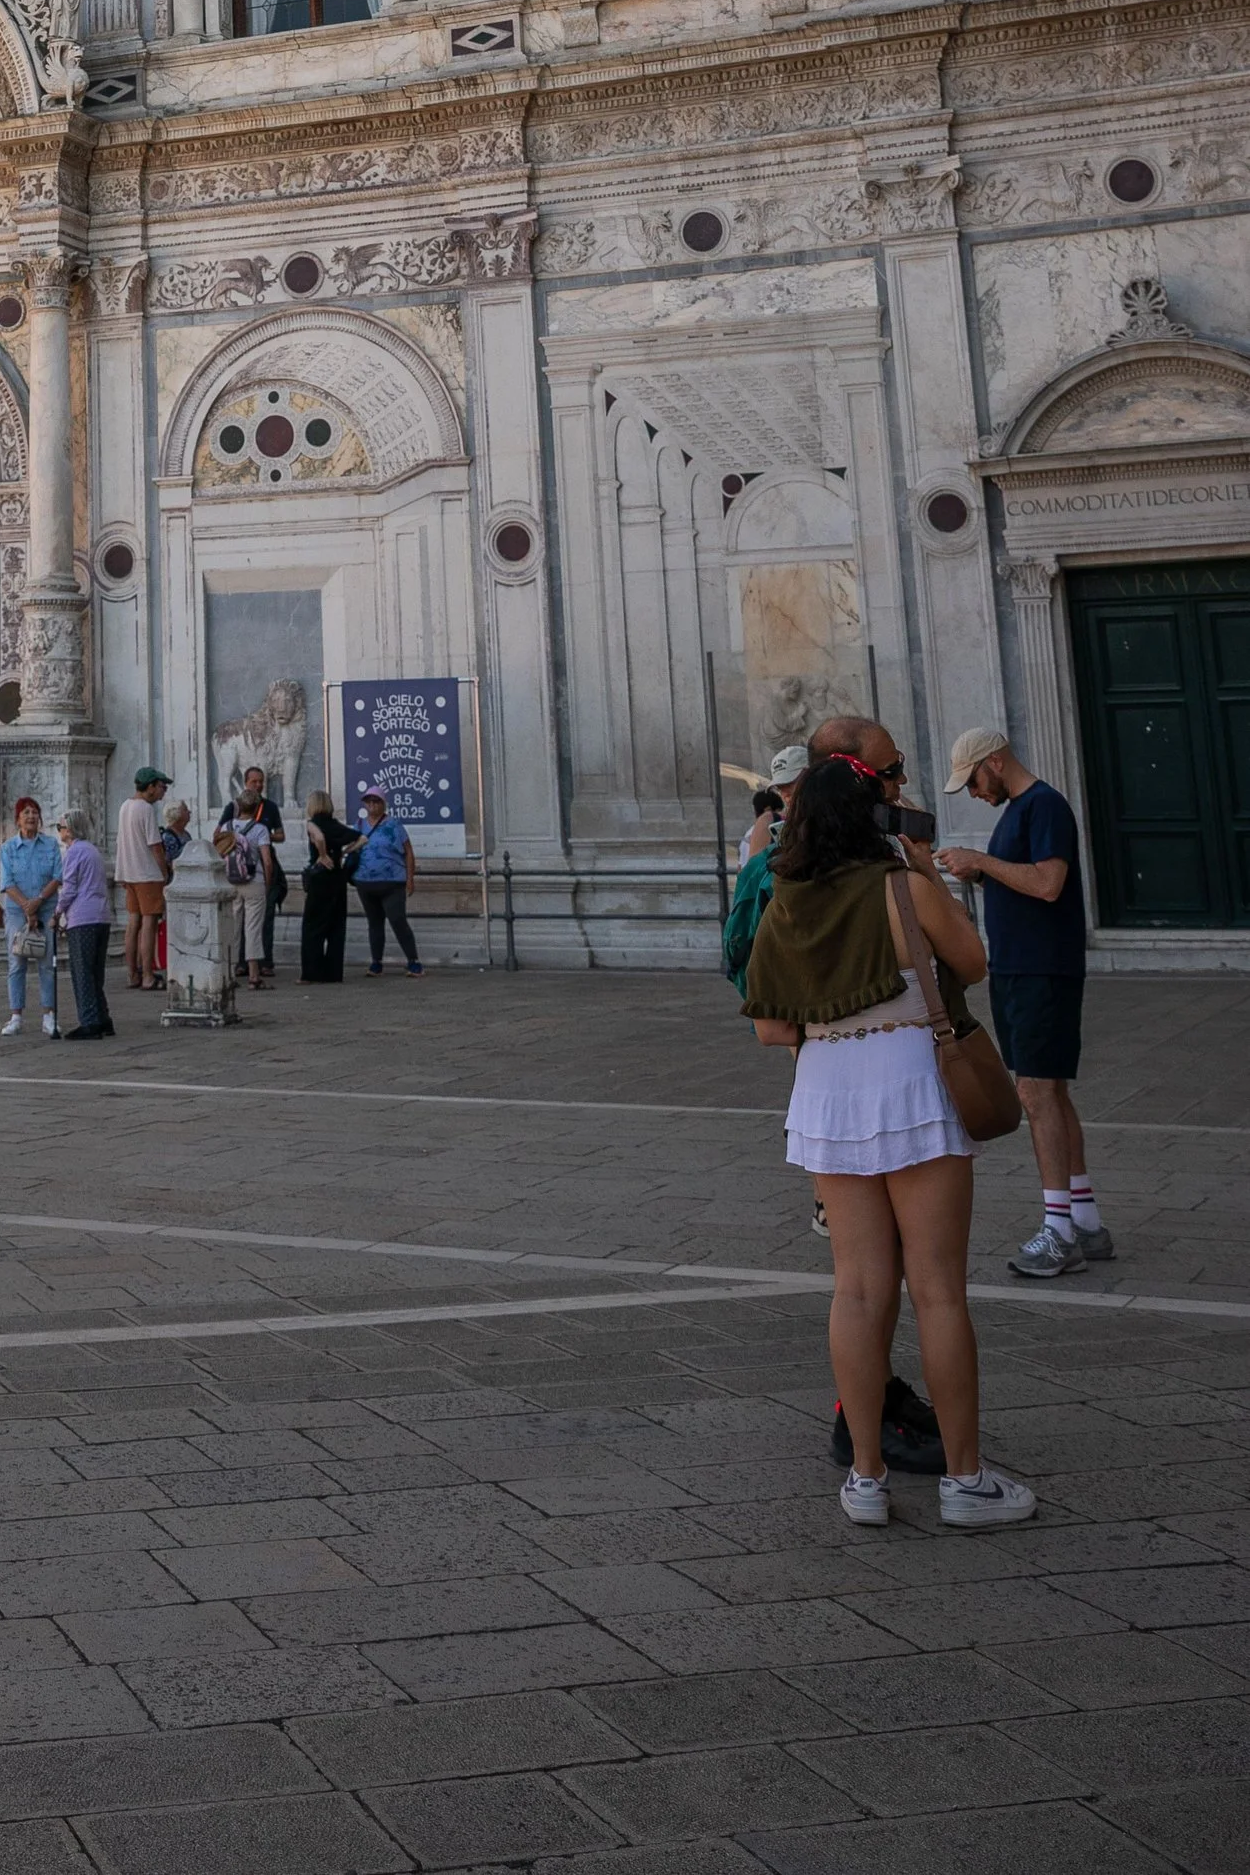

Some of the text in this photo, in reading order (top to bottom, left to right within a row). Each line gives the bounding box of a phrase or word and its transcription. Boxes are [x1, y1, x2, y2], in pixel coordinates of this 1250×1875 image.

[376, 694, 424, 709] IL CIELO
[372, 706, 430, 721] SOPRA AL
[371, 717, 431, 734] PORTEGO
[384, 734, 418, 748] AMDL
[379, 746, 424, 762] CIRCLE
[373, 764, 432, 784] MICHELE
[388, 776, 434, 799] LUCCHI
[393, 793, 412, 806] 8.5
